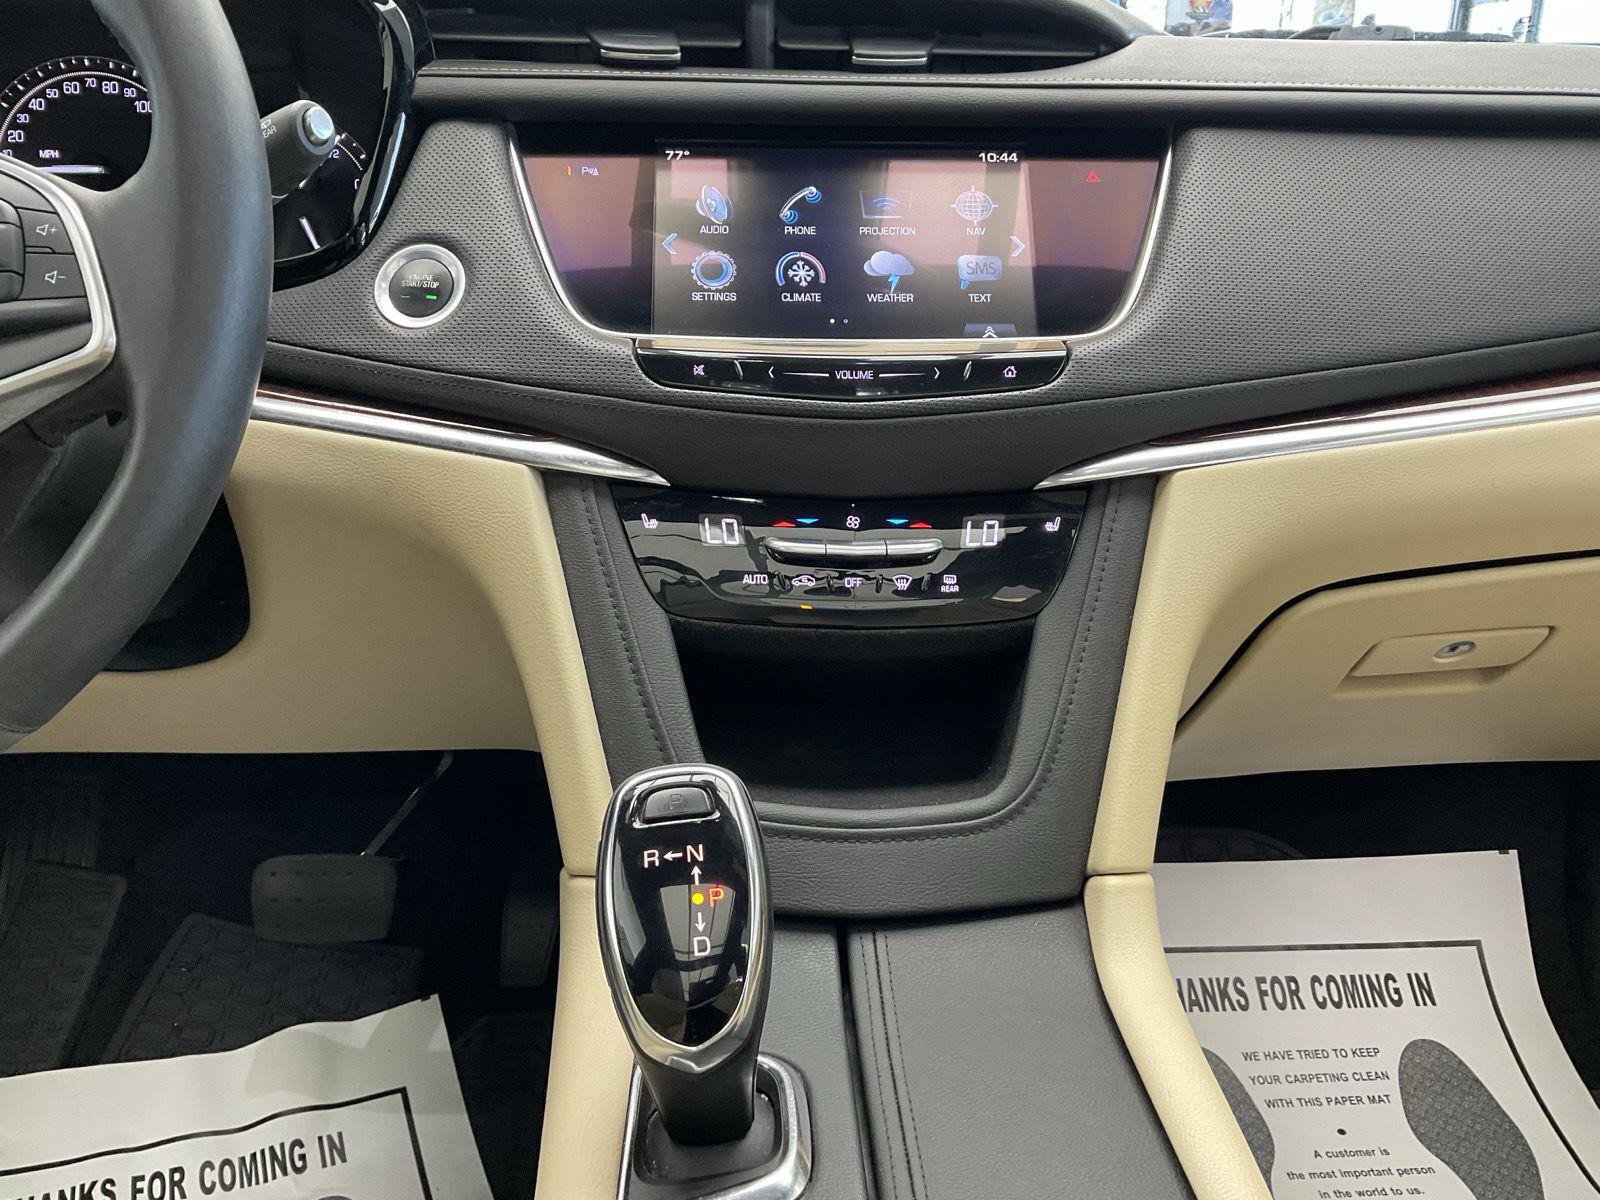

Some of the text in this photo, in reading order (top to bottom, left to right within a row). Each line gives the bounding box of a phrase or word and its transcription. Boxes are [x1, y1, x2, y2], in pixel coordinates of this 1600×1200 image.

[63, 82, 80, 94] 60
[85, 78, 97, 88] 70
[102, 82, 119, 94] 80
[46, 89, 59, 98] 50
[124, 88, 136, 98] 90
[29, 99, 45, 111] 40
[17, 114, 29, 123] 30
[8, 131, 24, 142] 20
[39, 150, 59, 158] MPH
[978, 152, 1018, 163] 10:44
[700, 225, 729, 234] AUDIO
[785, 226, 816, 235] PHONE
[859, 226, 916, 236] PROJECTION
[966, 227, 986, 236] NAV
[966, 261, 996, 275] SMS
[401, 280, 440, 288] START/STOP
[692, 292, 737, 301] SETTINGS
[781, 293, 821, 302] CLIMATE
[867, 293, 914, 302] WEATHER
[968, 293, 991, 302] TEXT
[835, 370, 874, 380] VOLUME
[743, 574, 768, 585] AUTO
[844, 576, 862, 588] OFF
[941, 584, 959, 592] REAR
[686, 844, 704, 862] N
[643, 850, 660, 868] R
[708, 888, 724, 907] P
[694, 936, 711, 956] D
[1255, 975, 1306, 1011] FOR
[1310, 973, 1404, 1010] COMING
[1407, 972, 1438, 1007] IN
[1242, 1046, 1380, 1062] WE HAVE TRIED TO KEEP
[1249, 1070, 1390, 1086] YOUR CARPETING CLEAN
[1264, 1093, 1391, 1109] WITH THIS PAPER MAT
[1314, 1147, 1390, 1159] A customer is
[131, 1166, 187, 1200] FOR
[199, 1138, 308, 1196] COMING
[317, 1131, 348, 1169] IN
[1287, 1166, 1436, 1181] the most important person
[1318, 1187, 1425, 1199] in the world to us.
